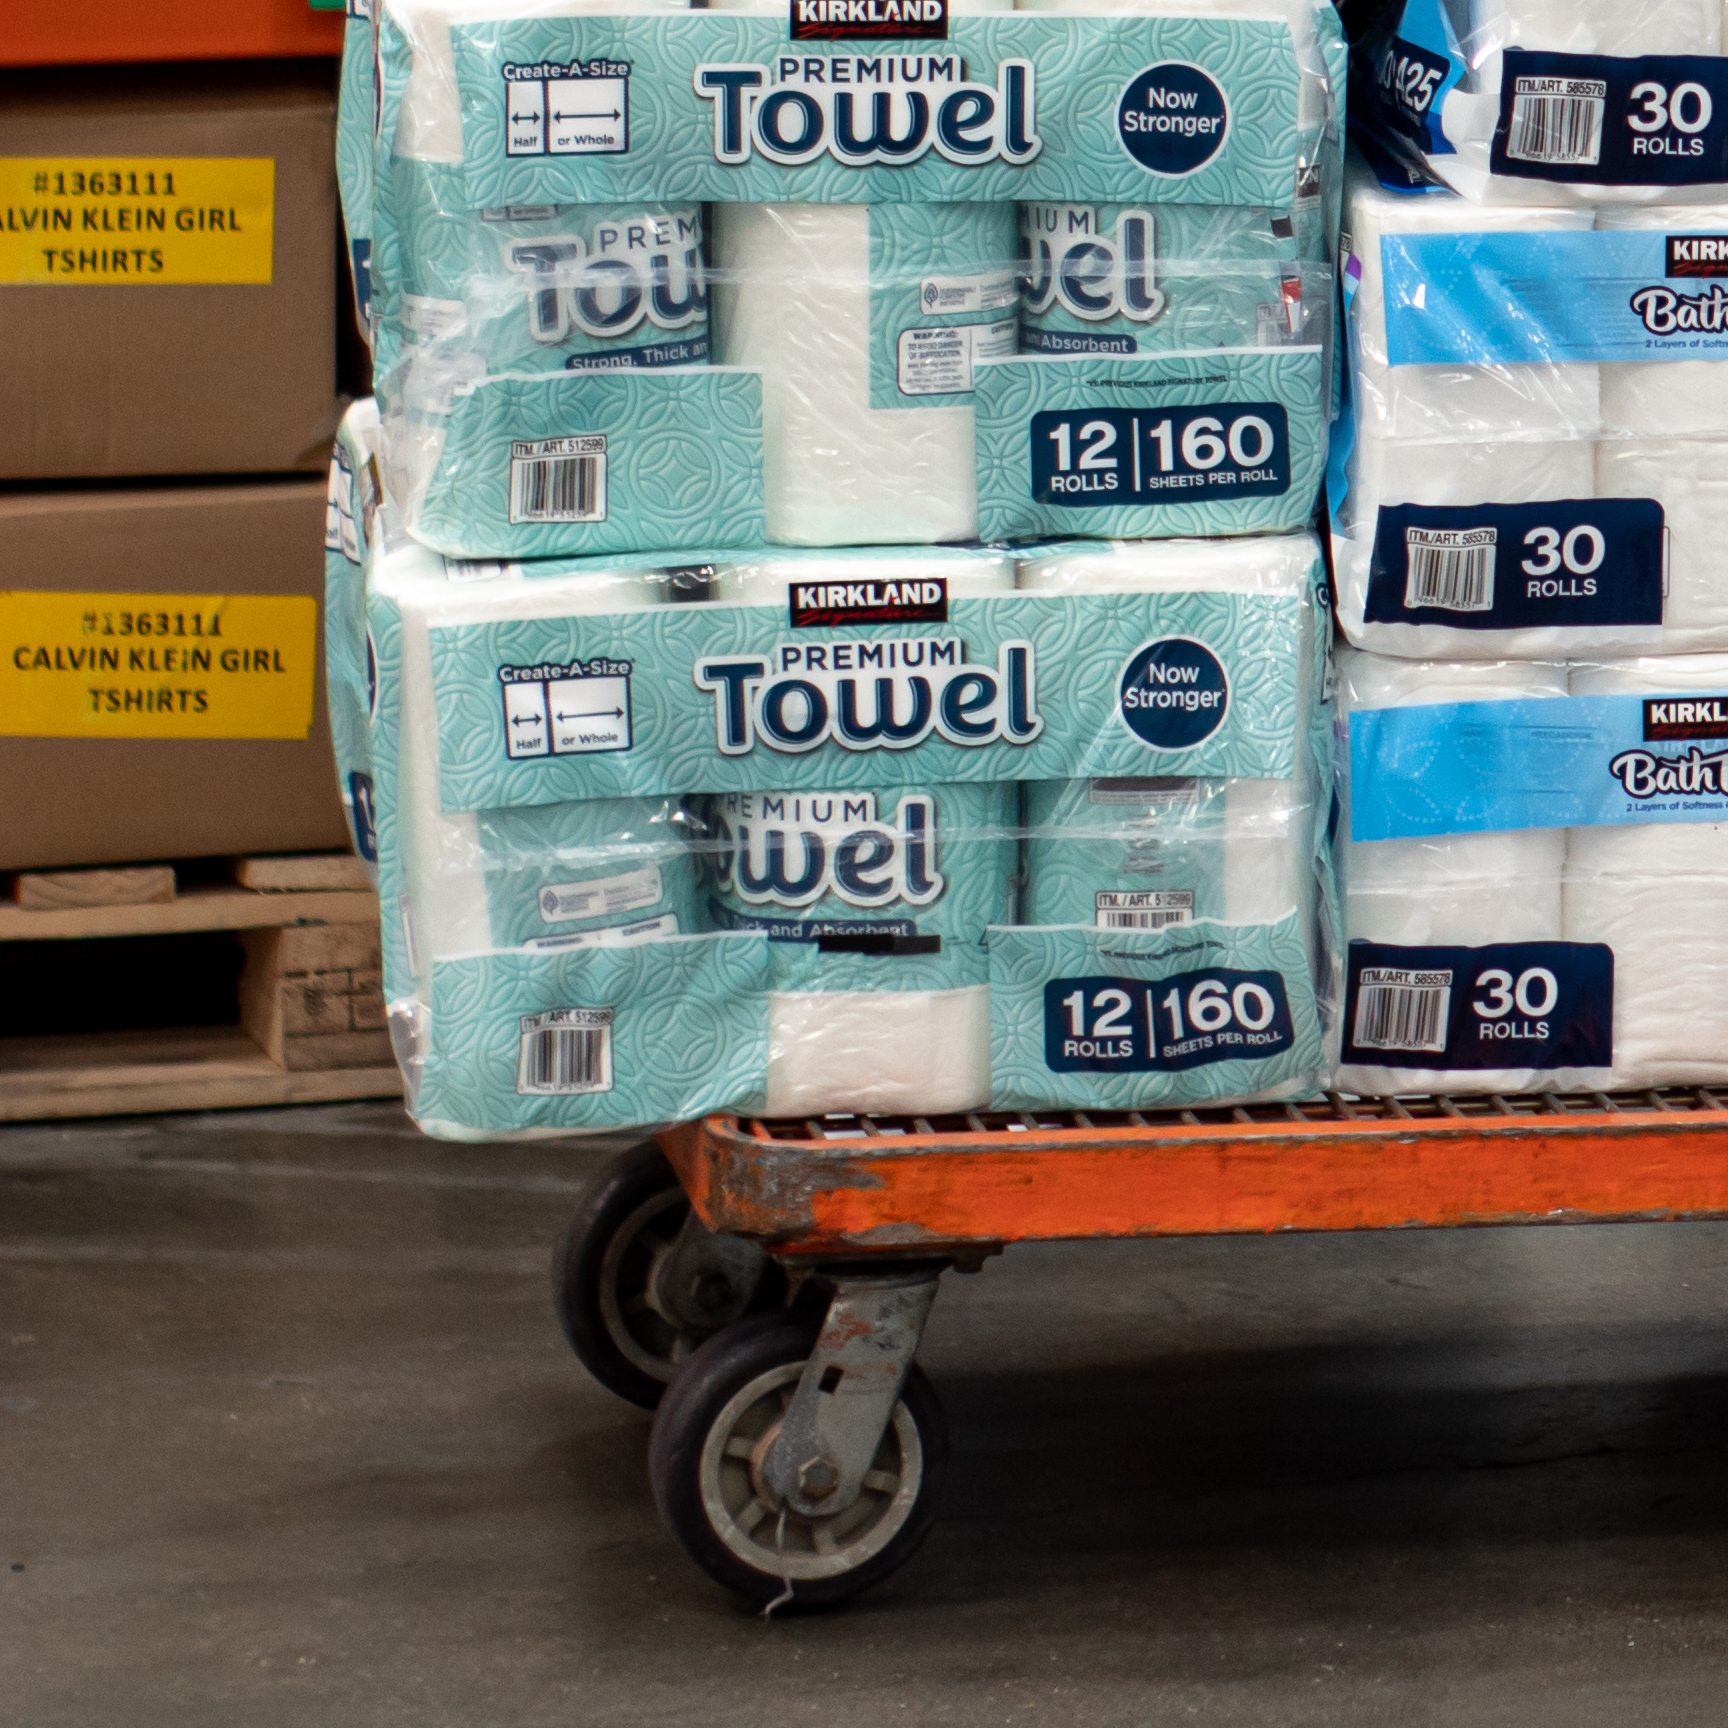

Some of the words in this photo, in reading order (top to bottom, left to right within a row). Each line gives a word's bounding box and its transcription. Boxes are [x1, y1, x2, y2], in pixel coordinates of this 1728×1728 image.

[799, 0, 943, 21] KIRKLAND
[778, 57, 955, 83] PREMIUM
[1146, 87, 1198, 110] Now
[1565, 81, 1606, 96] 585578
[700, 66, 1035, 159] Towel
[1627, 82, 1712, 134] 30
[1122, 110, 1222, 138] Stronger
[1632, 135, 1704, 156] ROLLS
[31, 172, 176, 196] #1363111
[82, 207, 166, 232] KLEIN
[174, 208, 242, 233] GIRL
[41, 249, 164, 274] TSHIRTS
[1049, 423, 1119, 469] 12
[1149, 416, 1275, 469] 160
[1049, 471, 1119, 493] ROLLS
[1520, 525, 1605, 577] 30
[795, 580, 943, 610] KIRKLAND
[80, 612, 223, 638] #1363111
[12, 646, 119, 672] CALVIN
[129, 648, 211, 673] KLEIN
[219, 648, 286, 673] GIRL
[780, 641, 957, 672] PREMIUM
[1146, 663, 1199, 686] Now
[88, 689, 209, 714] TSHIRTS
[701, 648, 1037, 747] Towel
[1122, 685, 1222, 712] Stronger
[1471, 967, 1559, 1019] 30
[1062, 987, 1133, 1036] 12
[1161, 981, 1275, 1034] 160
